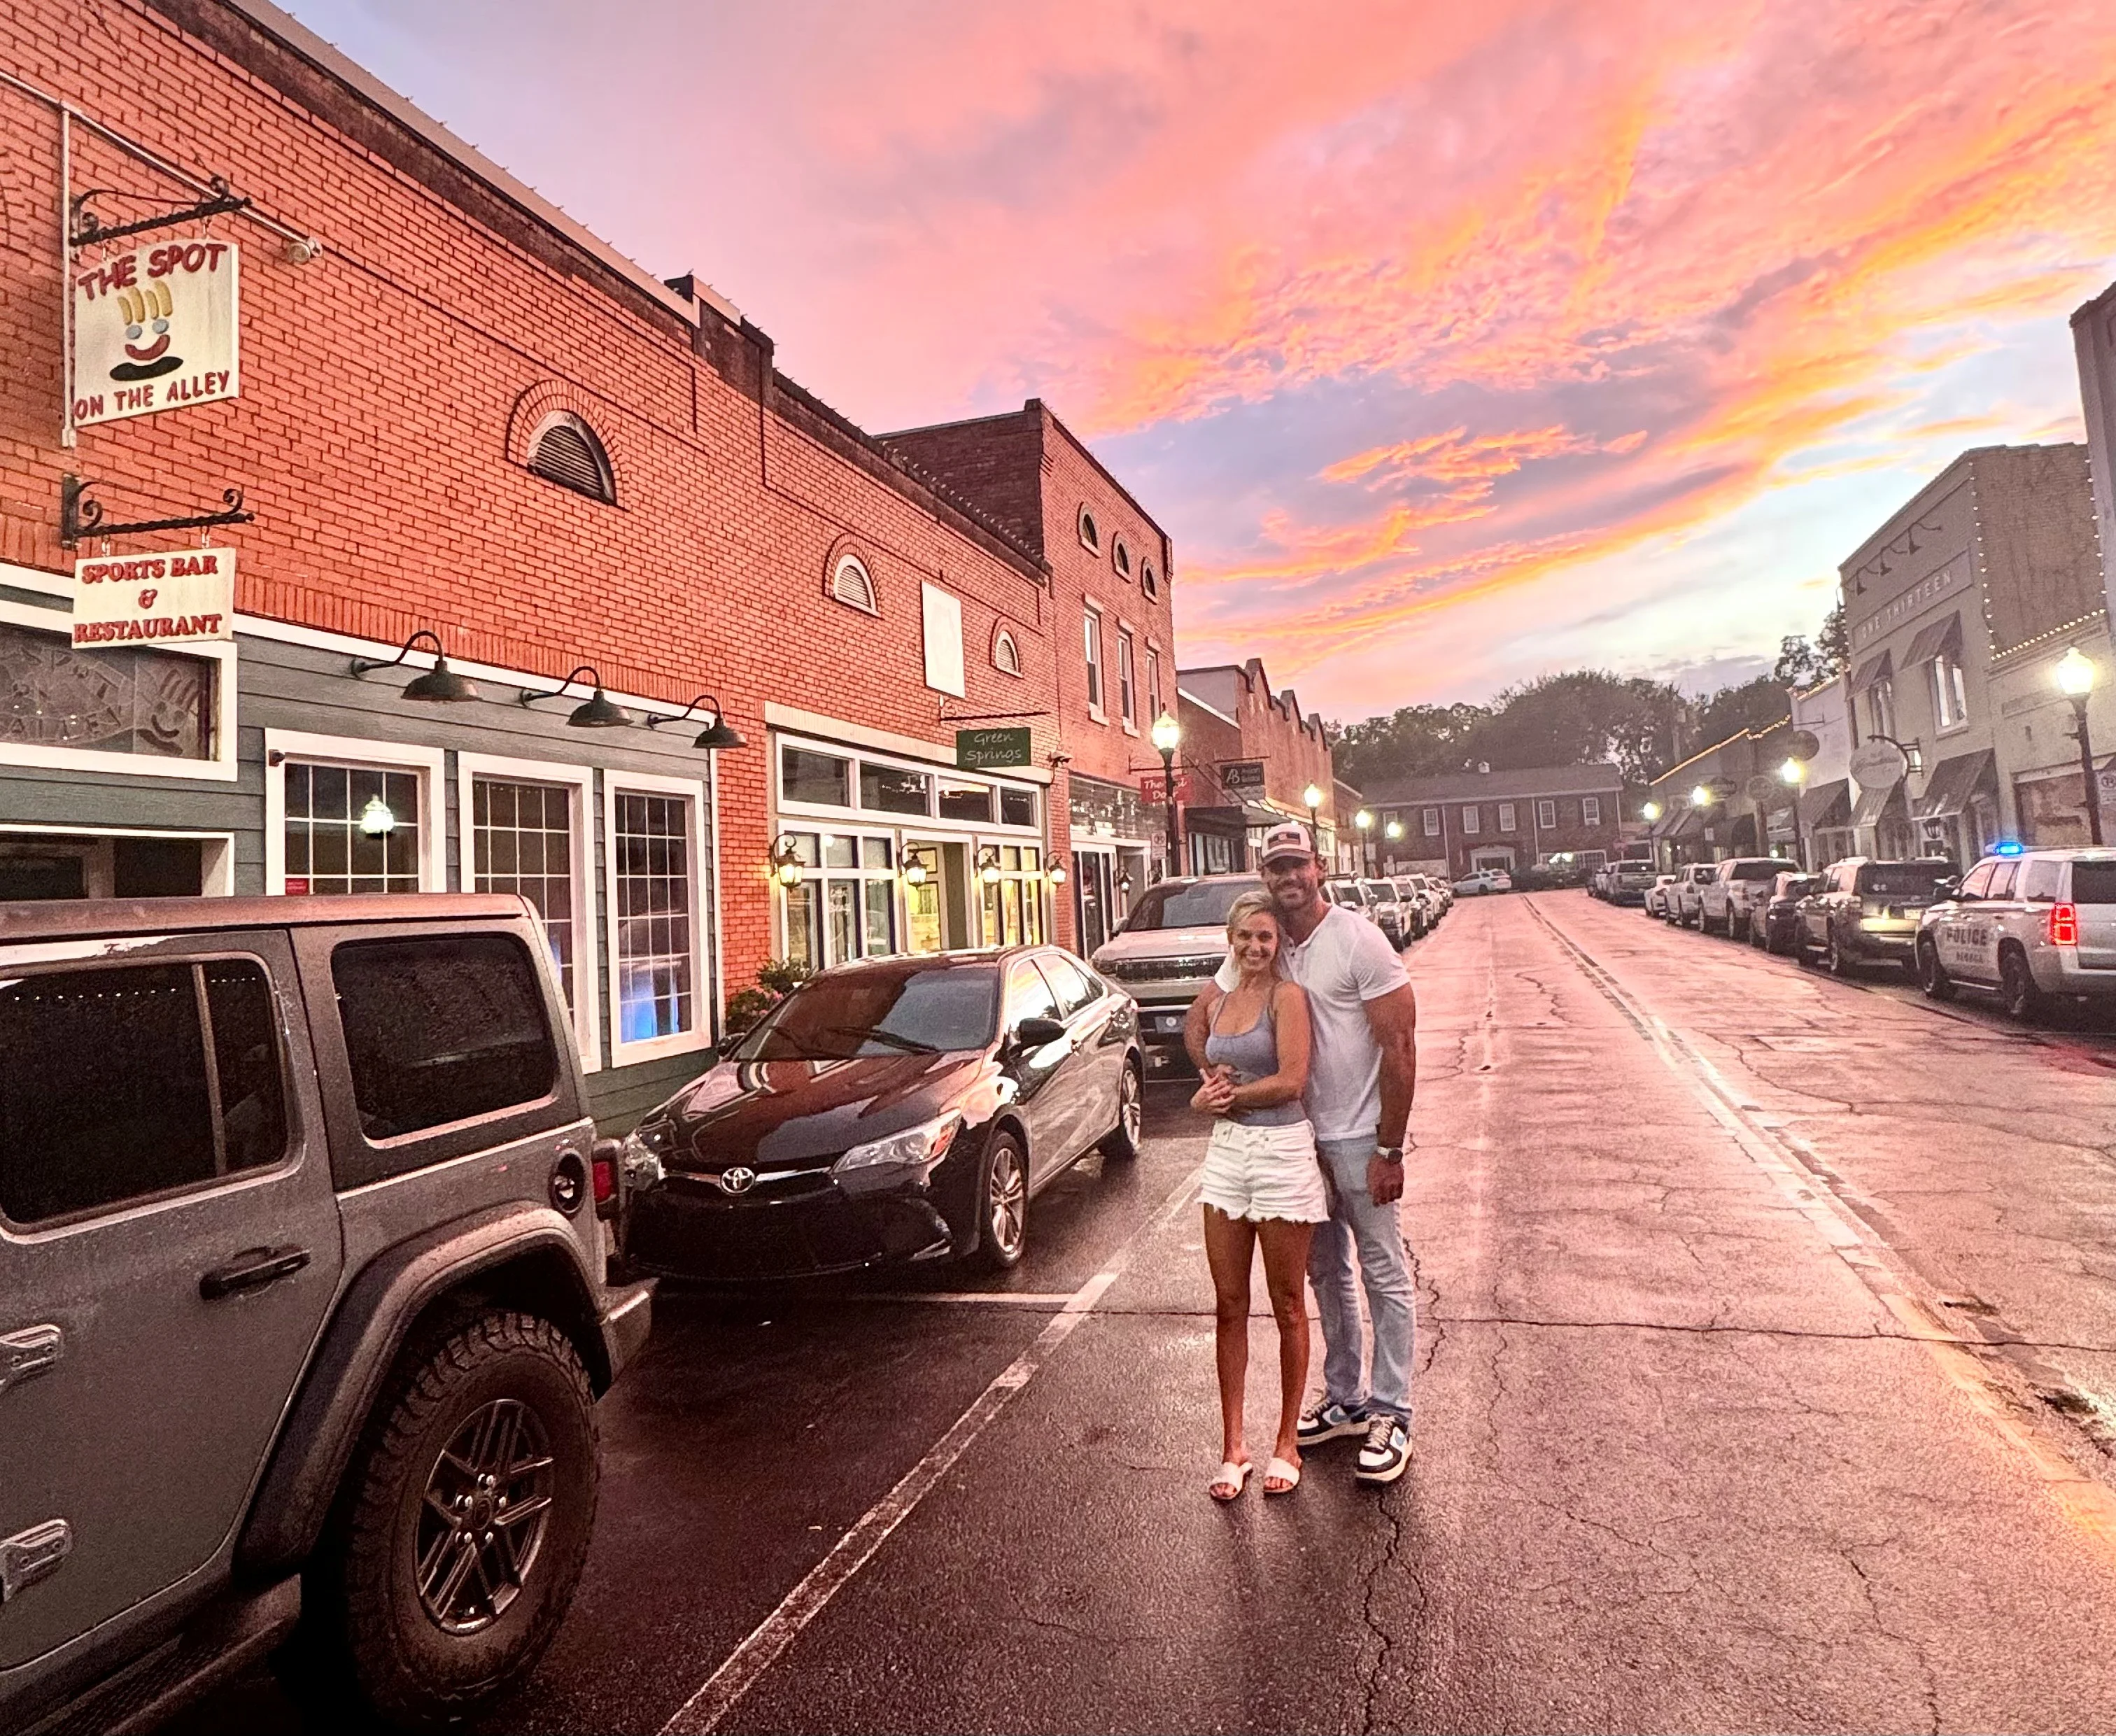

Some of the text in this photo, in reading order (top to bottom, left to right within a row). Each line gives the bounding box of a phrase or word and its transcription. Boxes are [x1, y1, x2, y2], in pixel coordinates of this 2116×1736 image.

[78, 243, 228, 301] THE SPOT
[73, 370, 230, 421] ON THE ALLEY
[81, 555, 218, 584] SPORTS BAR
[138, 588, 158, 609] &
[1886, 570, 1952, 623] THIRTEEN
[73, 613, 223, 643] RESTAURANT
[973, 732, 1015, 746] Green
[965, 747, 1022, 765] Springs
[1144, 779, 1164, 789] The
[1152, 790, 1179, 800] Dor
[1947, 926, 1987, 946] POLICE
